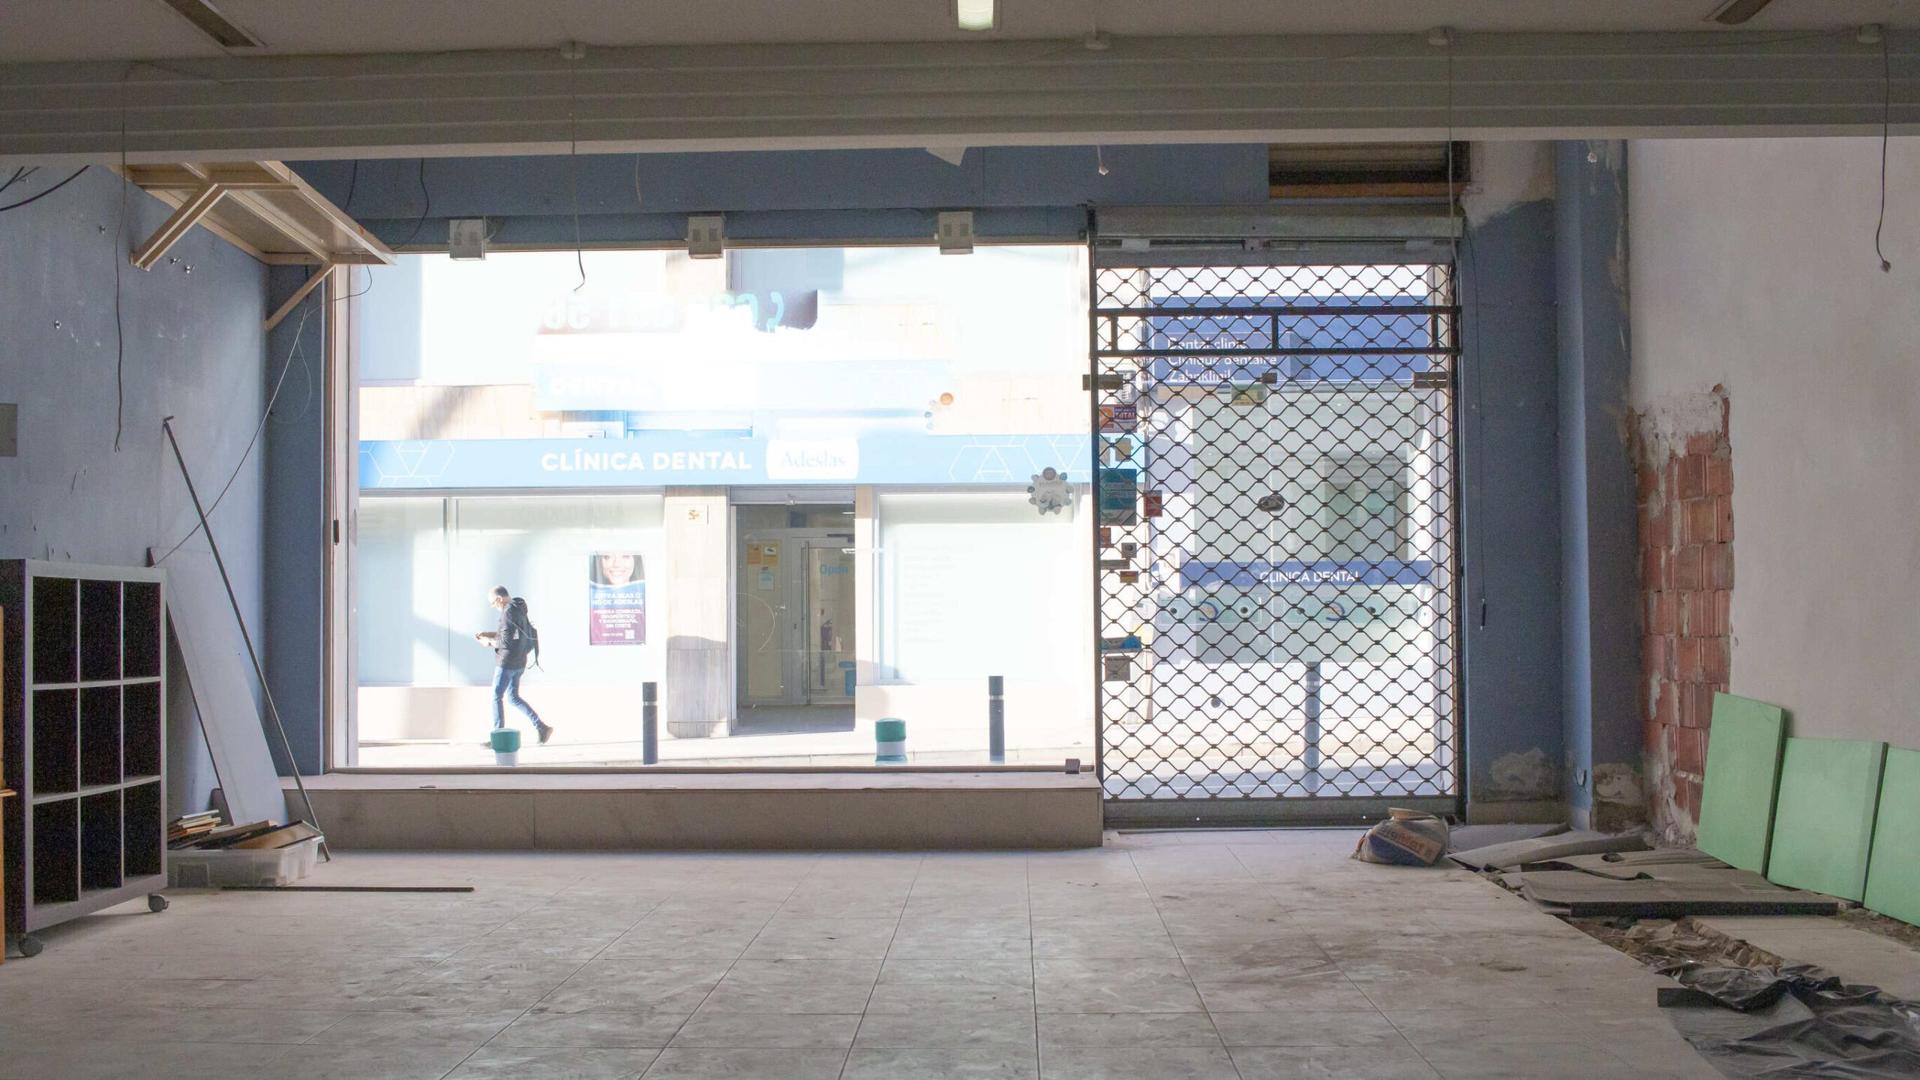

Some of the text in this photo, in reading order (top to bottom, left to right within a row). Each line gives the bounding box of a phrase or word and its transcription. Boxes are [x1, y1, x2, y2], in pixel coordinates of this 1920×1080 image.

[541, 448, 752, 471] CLÍNICA DENTAL
[781, 449, 847, 468] Adeslas
